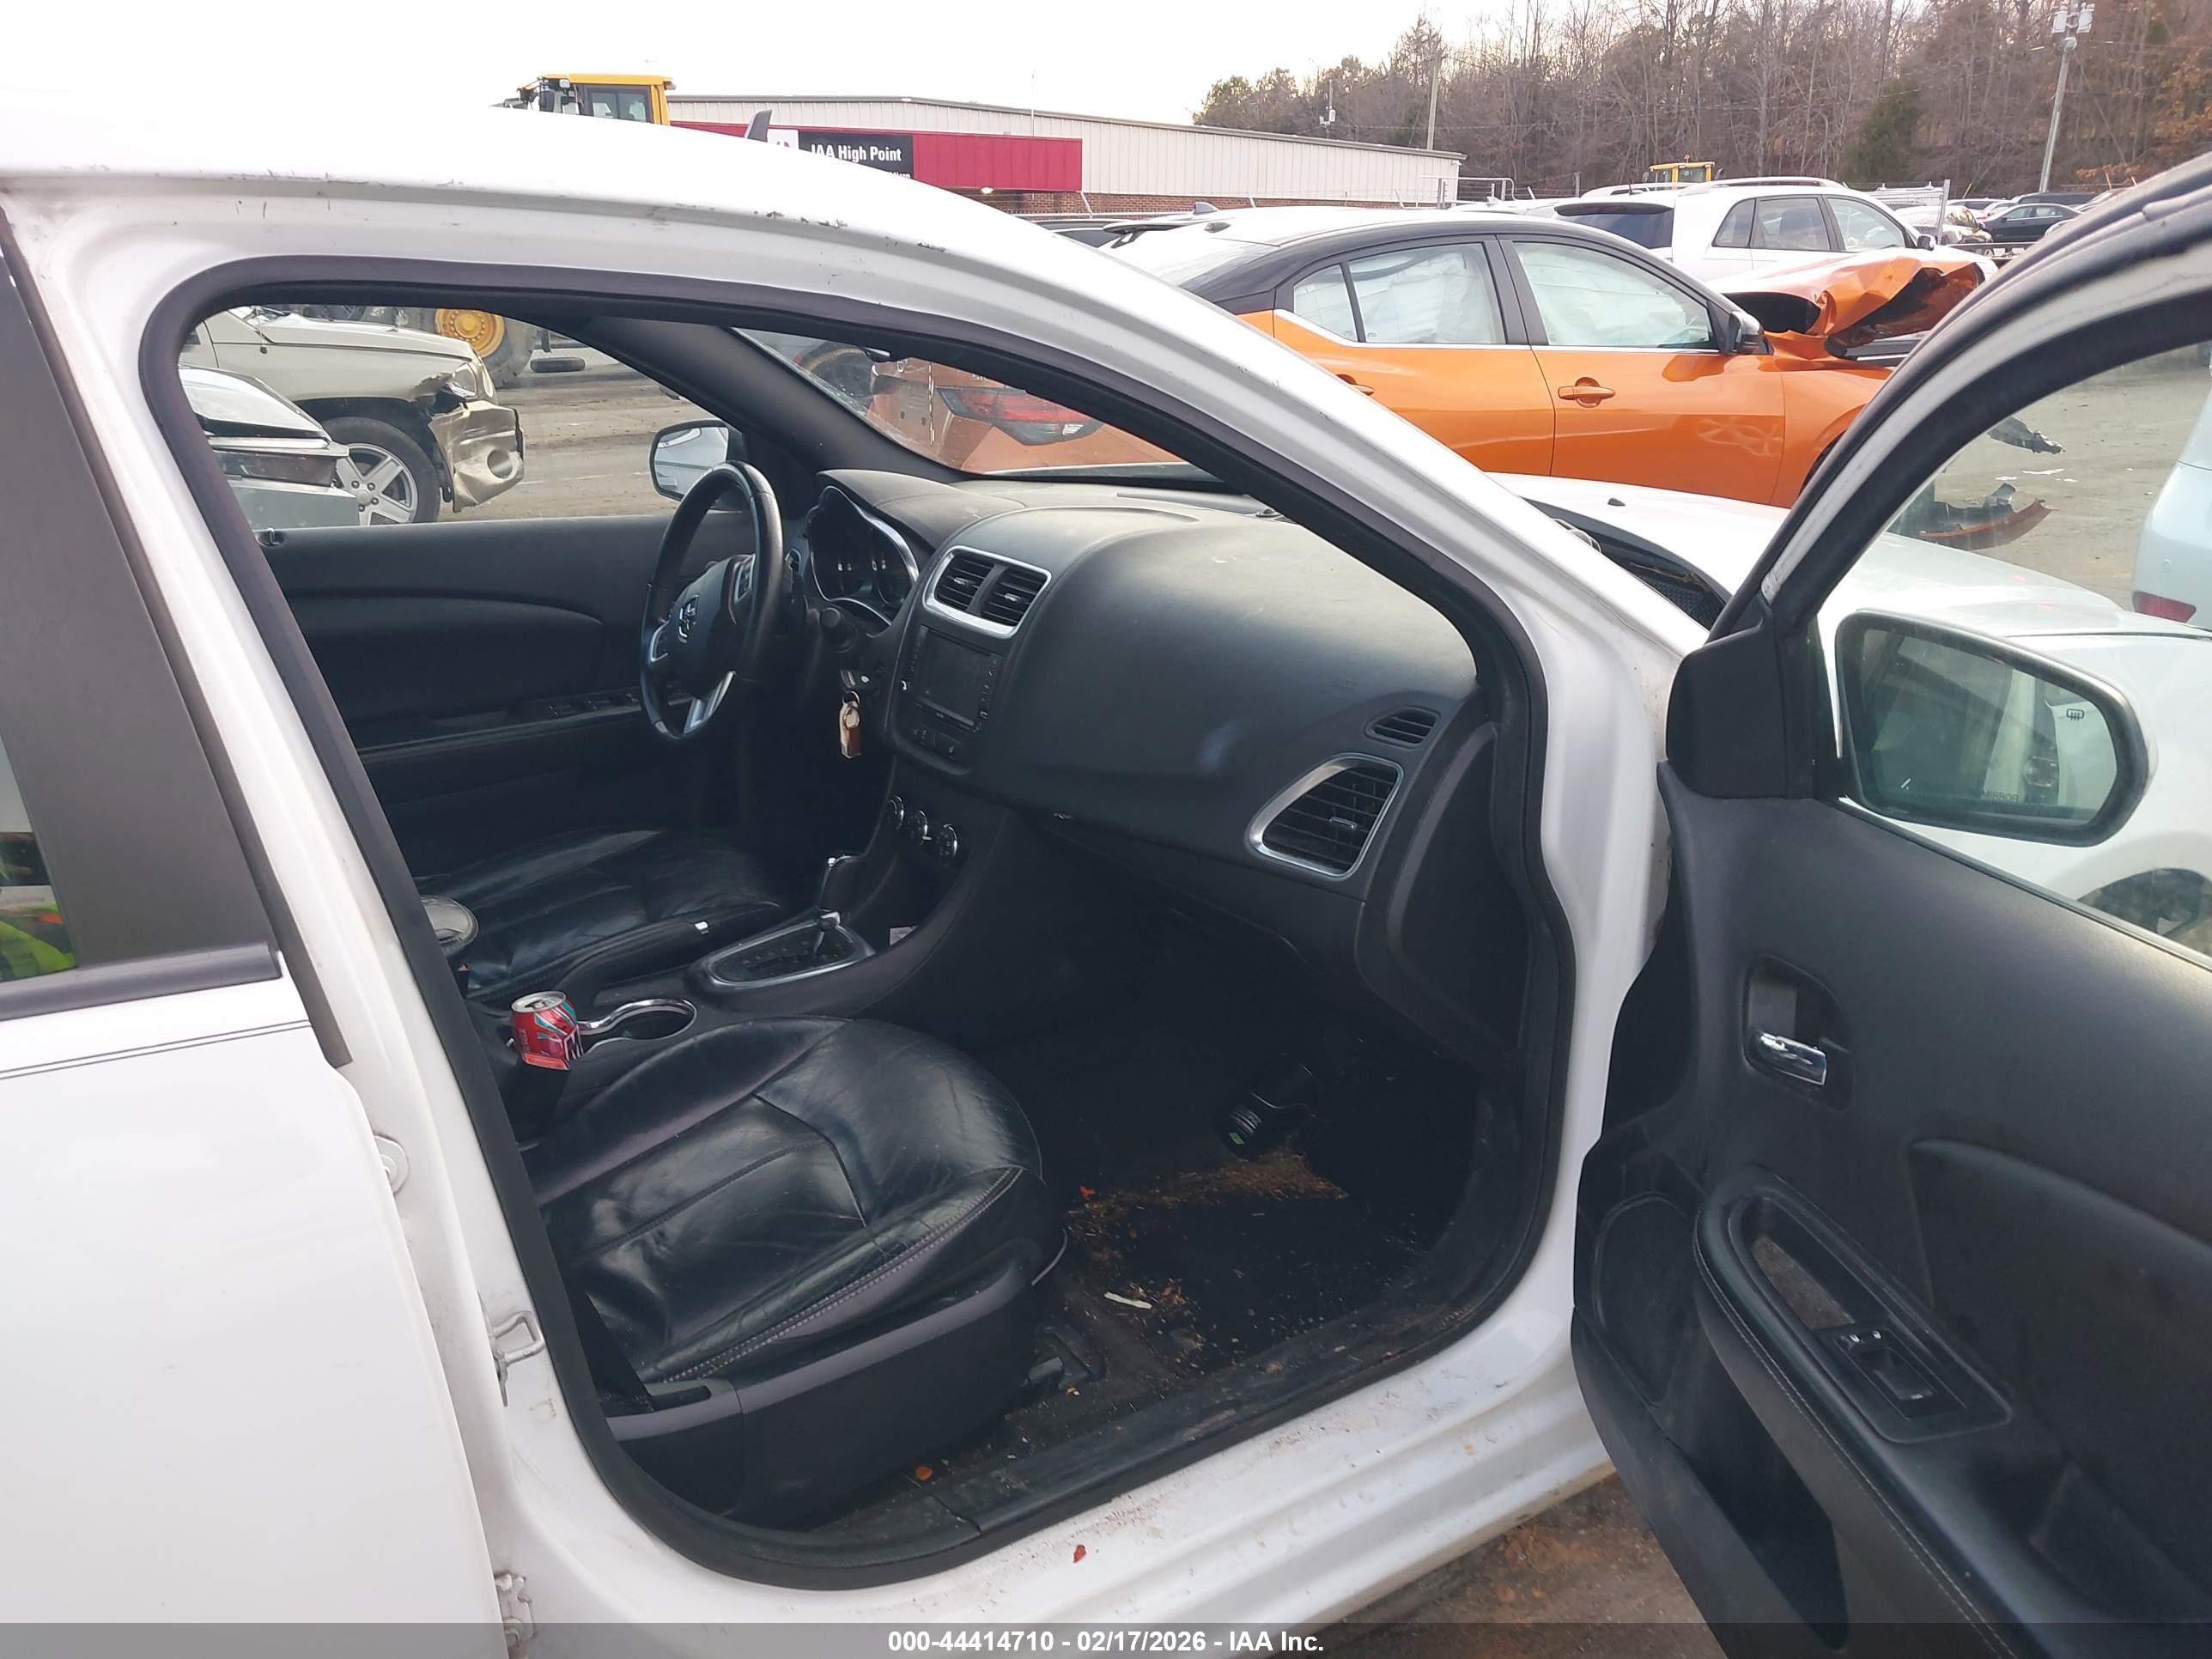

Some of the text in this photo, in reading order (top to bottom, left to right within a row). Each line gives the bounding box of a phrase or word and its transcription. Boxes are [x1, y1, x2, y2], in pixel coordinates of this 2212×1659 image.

[811, 143, 902, 163] IAA High Point
[1980, 789, 2020, 804] MIRROR
